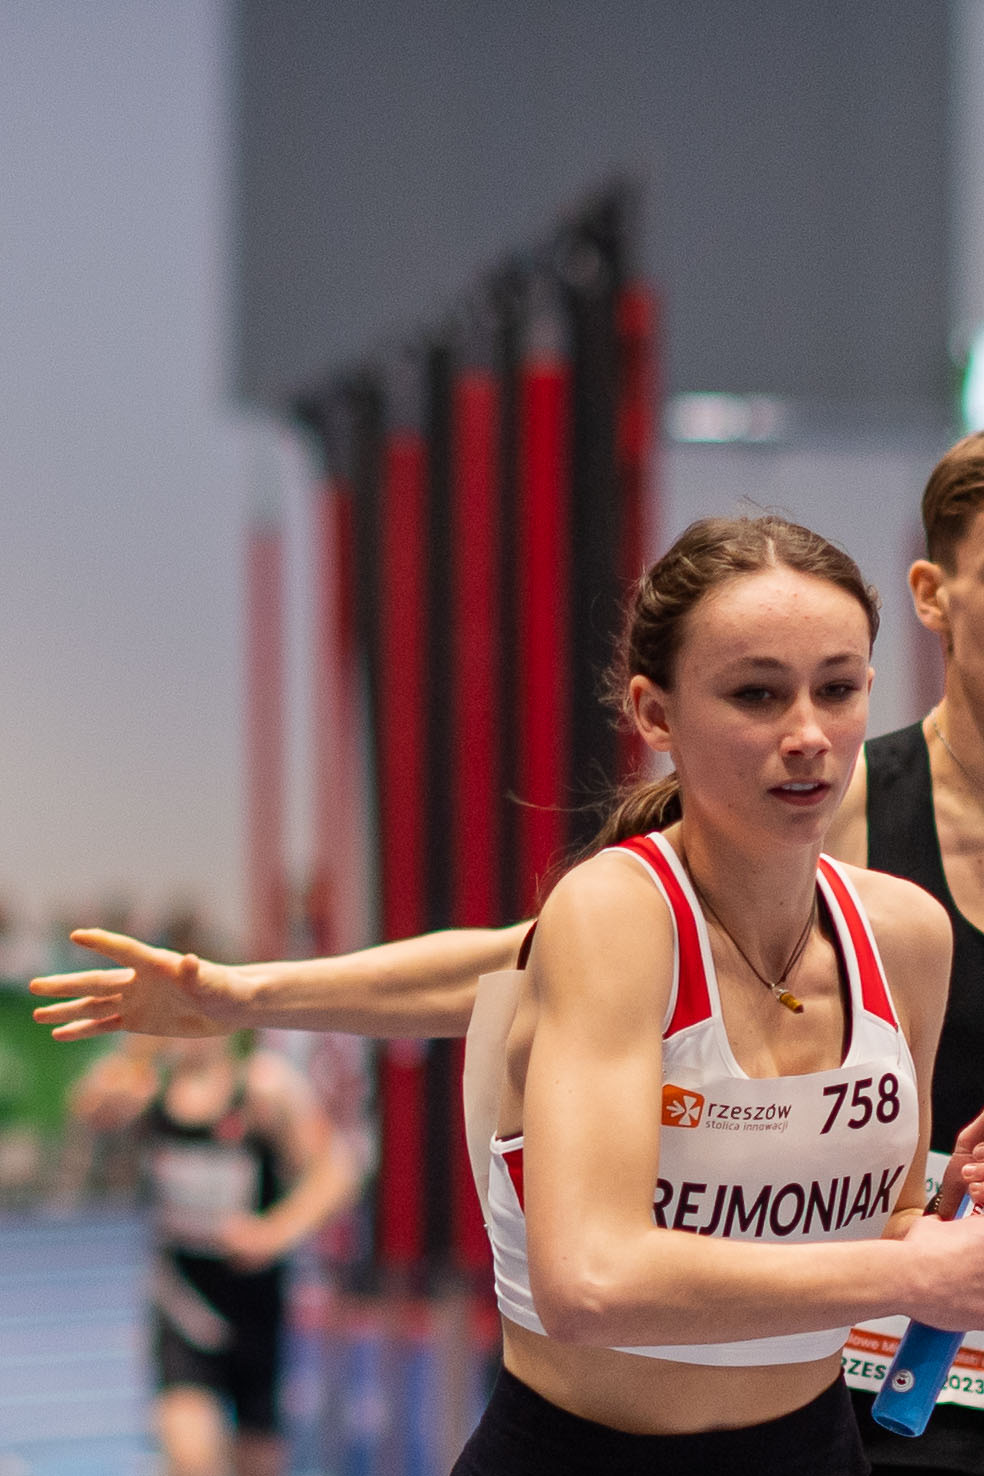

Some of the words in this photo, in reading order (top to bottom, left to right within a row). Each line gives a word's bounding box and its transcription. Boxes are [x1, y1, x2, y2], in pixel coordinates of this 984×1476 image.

[707, 1102, 792, 1121] rzeszów
[819, 1072, 901, 1135] 758
[705, 1119, 740, 1131] stolica
[742, 1120, 789, 1134] innowacji
[653, 1165, 905, 1238] REJMONIAK
